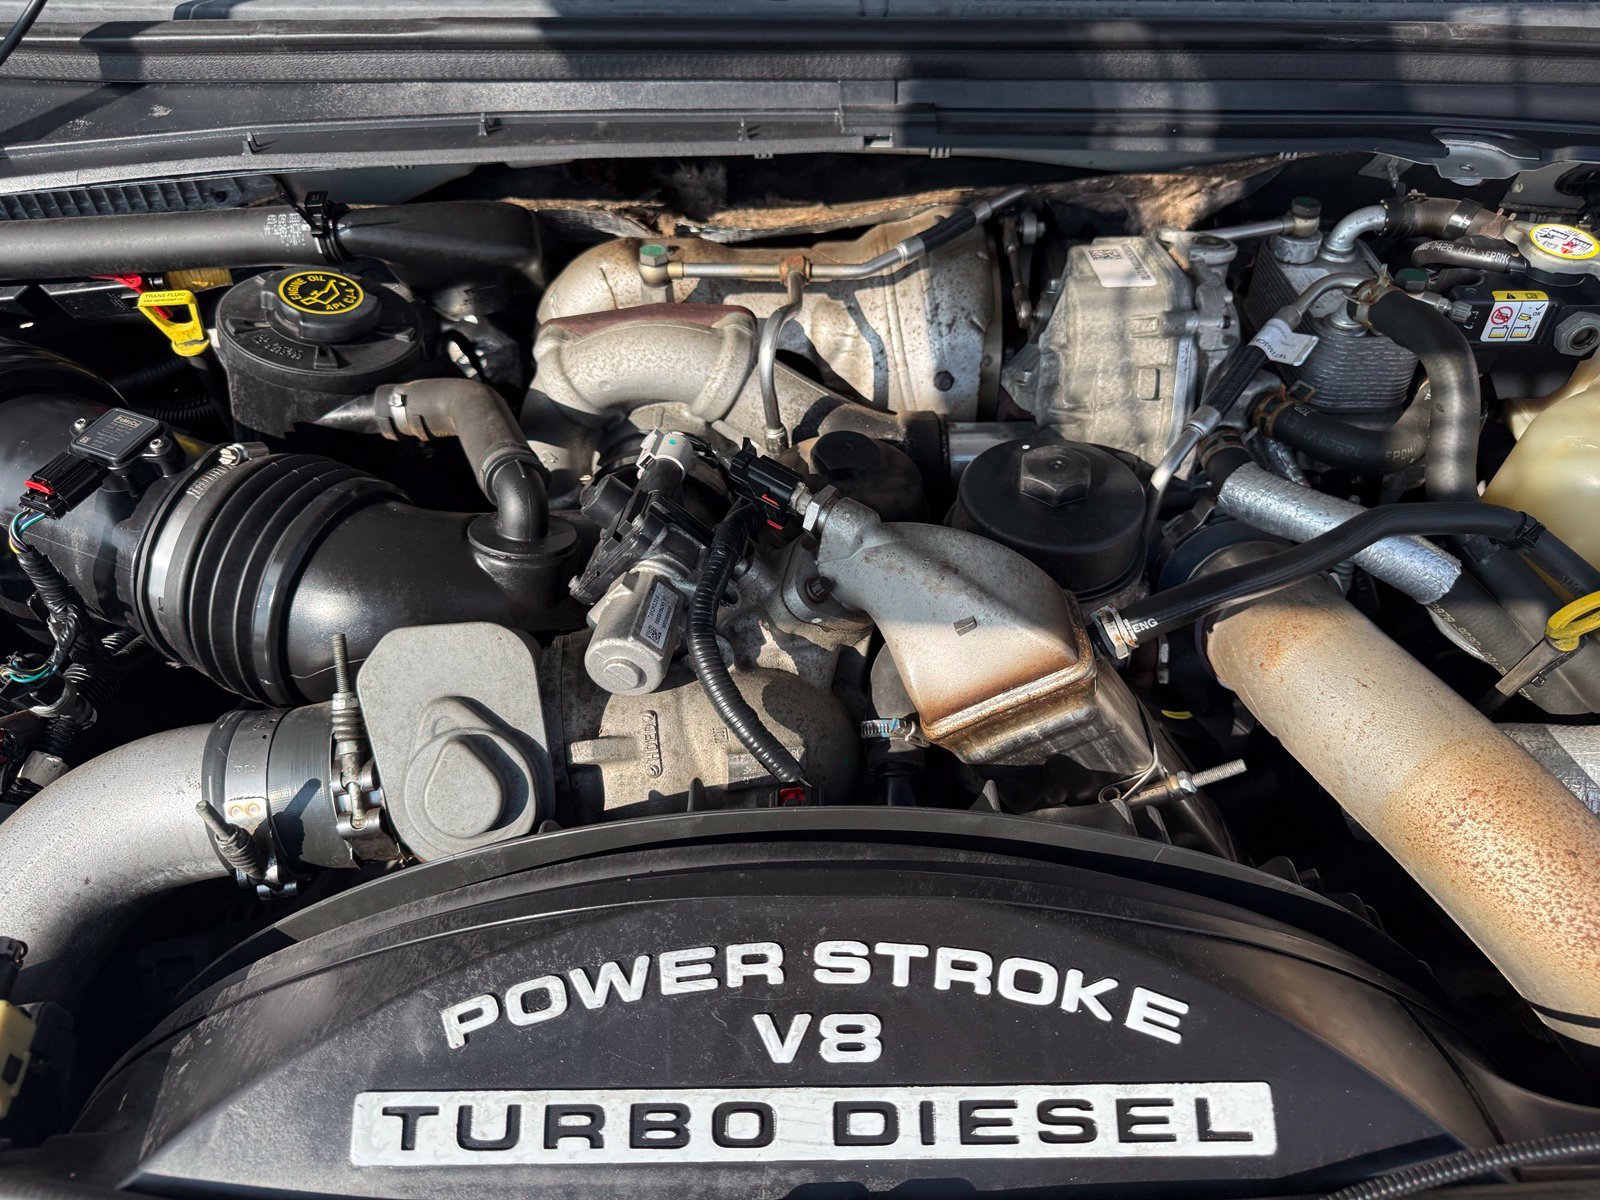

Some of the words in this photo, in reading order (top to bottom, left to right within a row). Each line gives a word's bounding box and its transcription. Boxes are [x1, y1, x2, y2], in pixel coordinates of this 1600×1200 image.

[287, 277, 307, 300] ENGINE
[325, 302, 346, 311] API
[343, 288, 357, 303] CJ-4
[1131, 618, 1159, 633] ENG
[441, 942, 784, 1049] POWER
[813, 940, 1190, 1045] STROKE
[752, 1013, 883, 1063] V8
[382, 1101, 778, 1151] TURBO
[833, 1097, 1254, 1146] DIESEL
